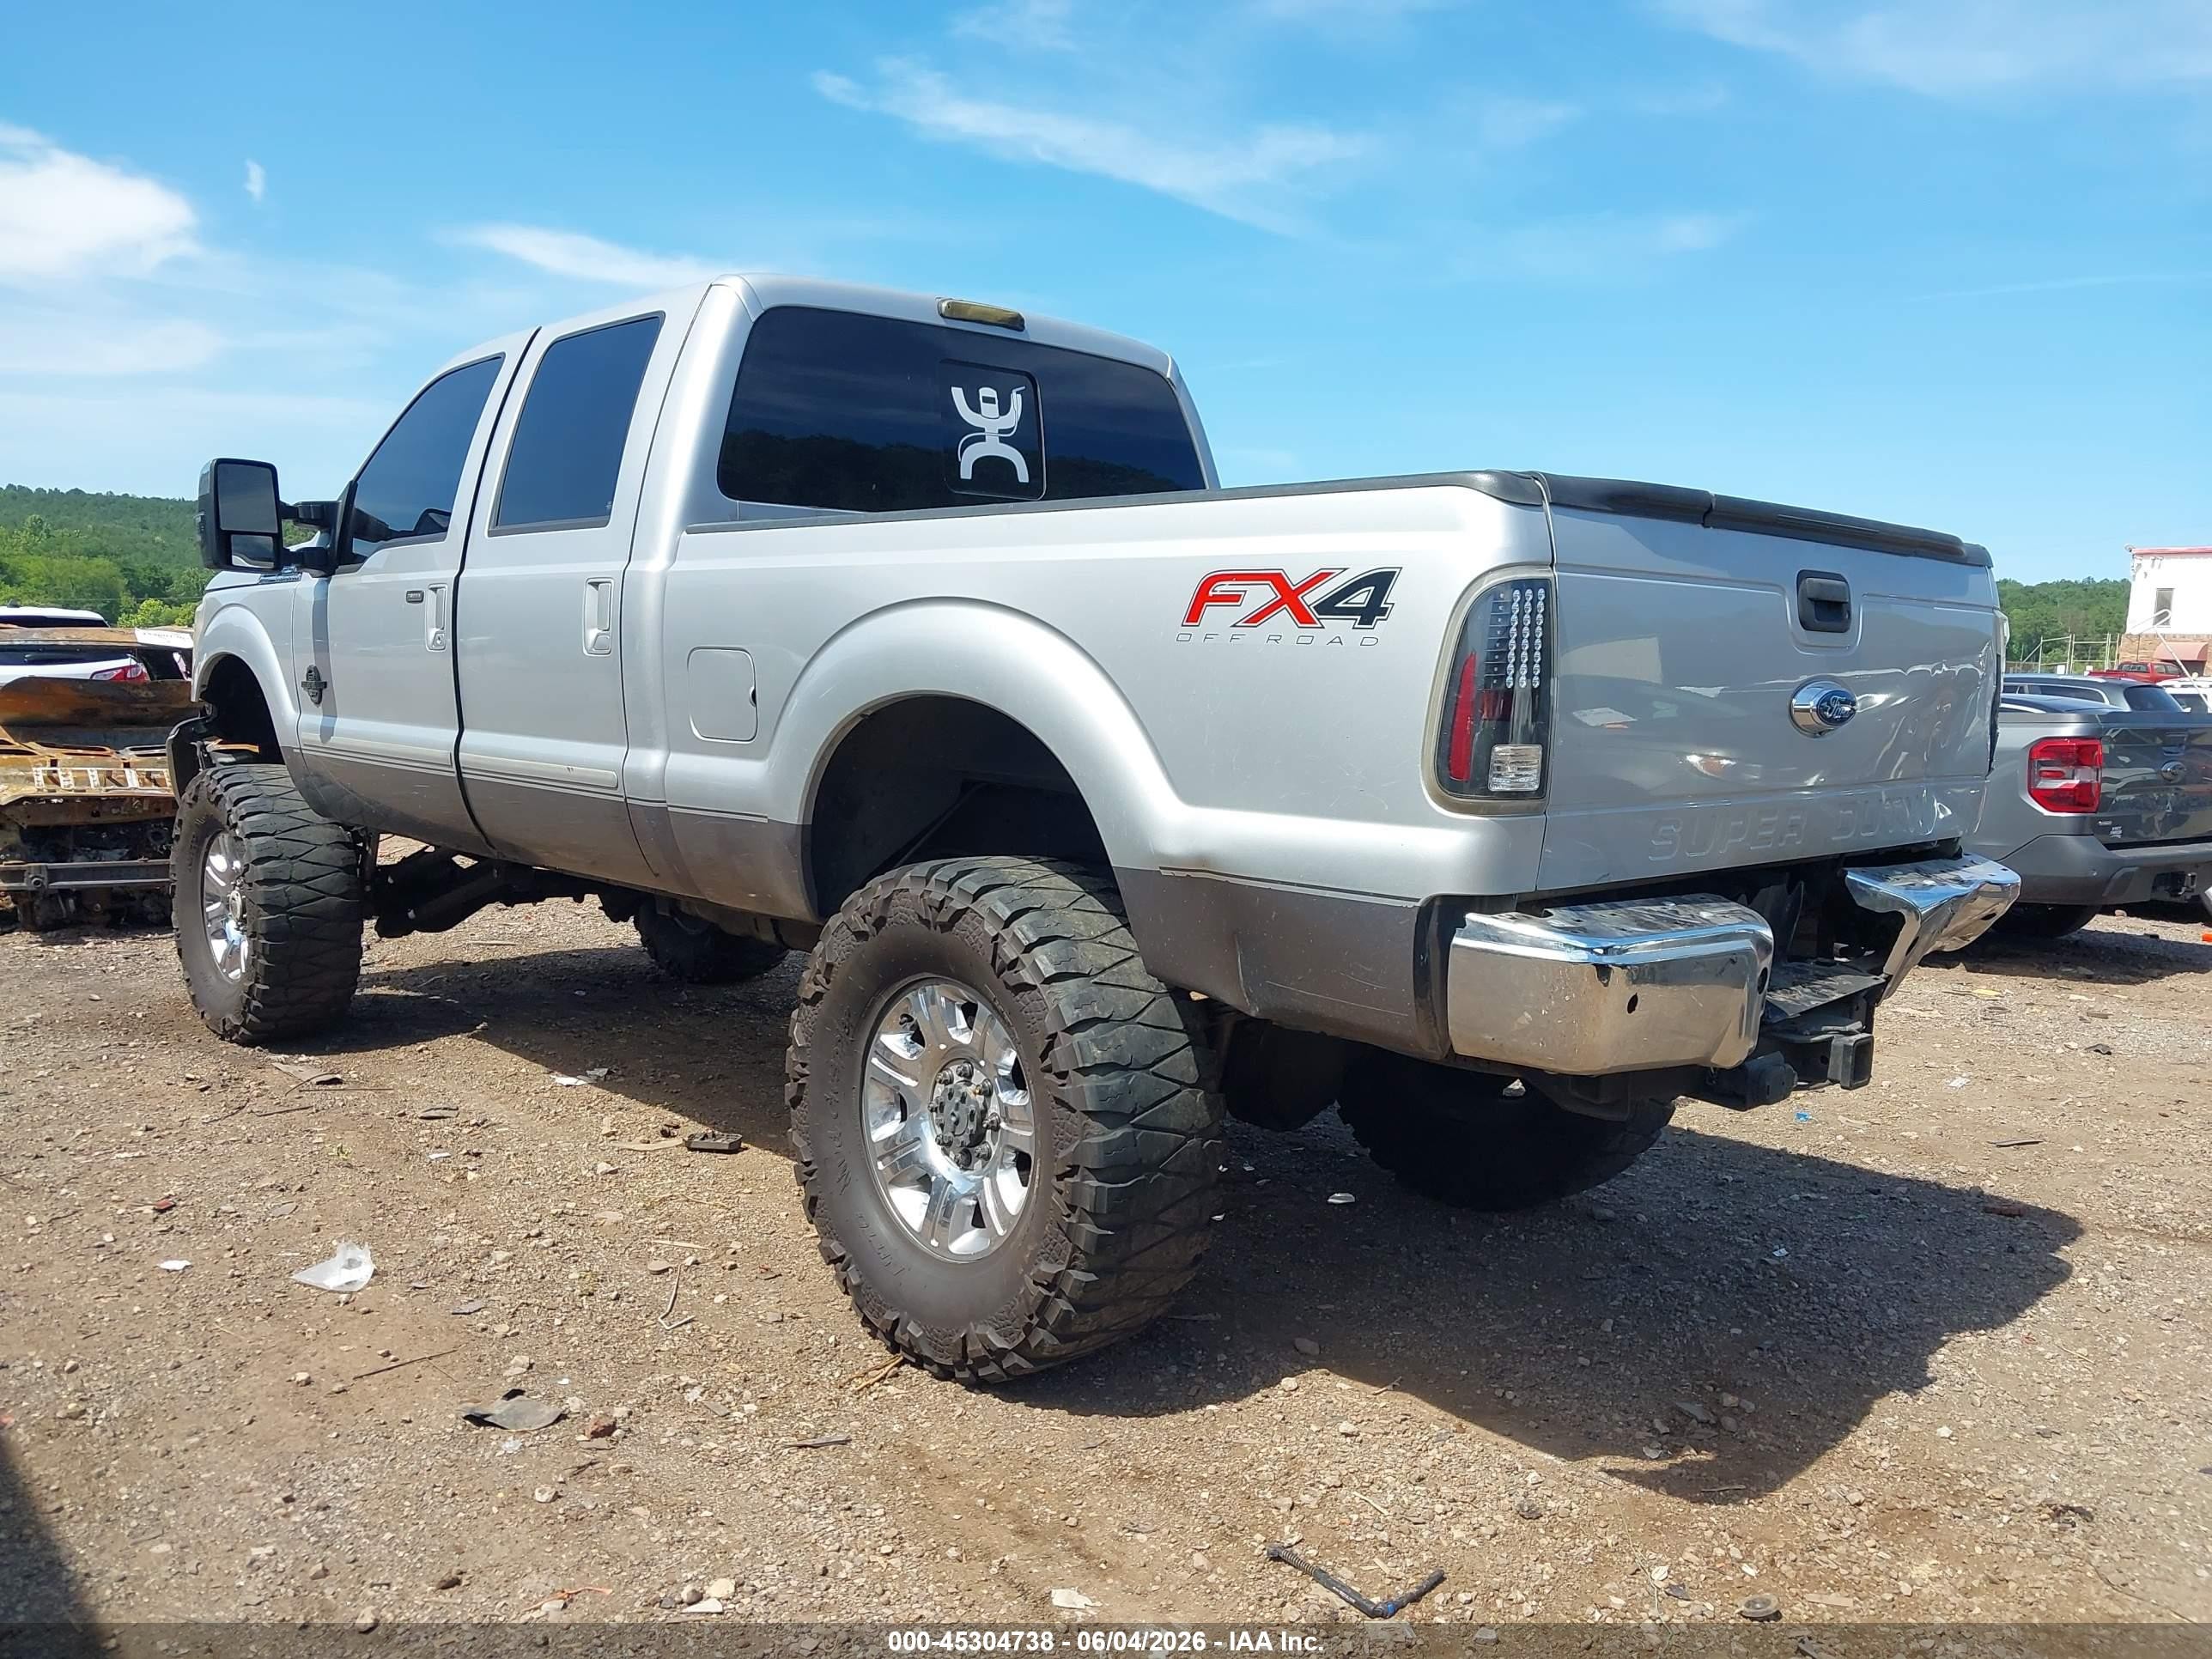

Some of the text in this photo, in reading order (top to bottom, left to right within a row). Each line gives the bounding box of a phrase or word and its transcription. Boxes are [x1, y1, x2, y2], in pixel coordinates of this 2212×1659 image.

[1181, 566, 1403, 630] FX4
[1176, 633, 1380, 647] OFF ROAD
[1648, 809, 1808, 861] SUPER
